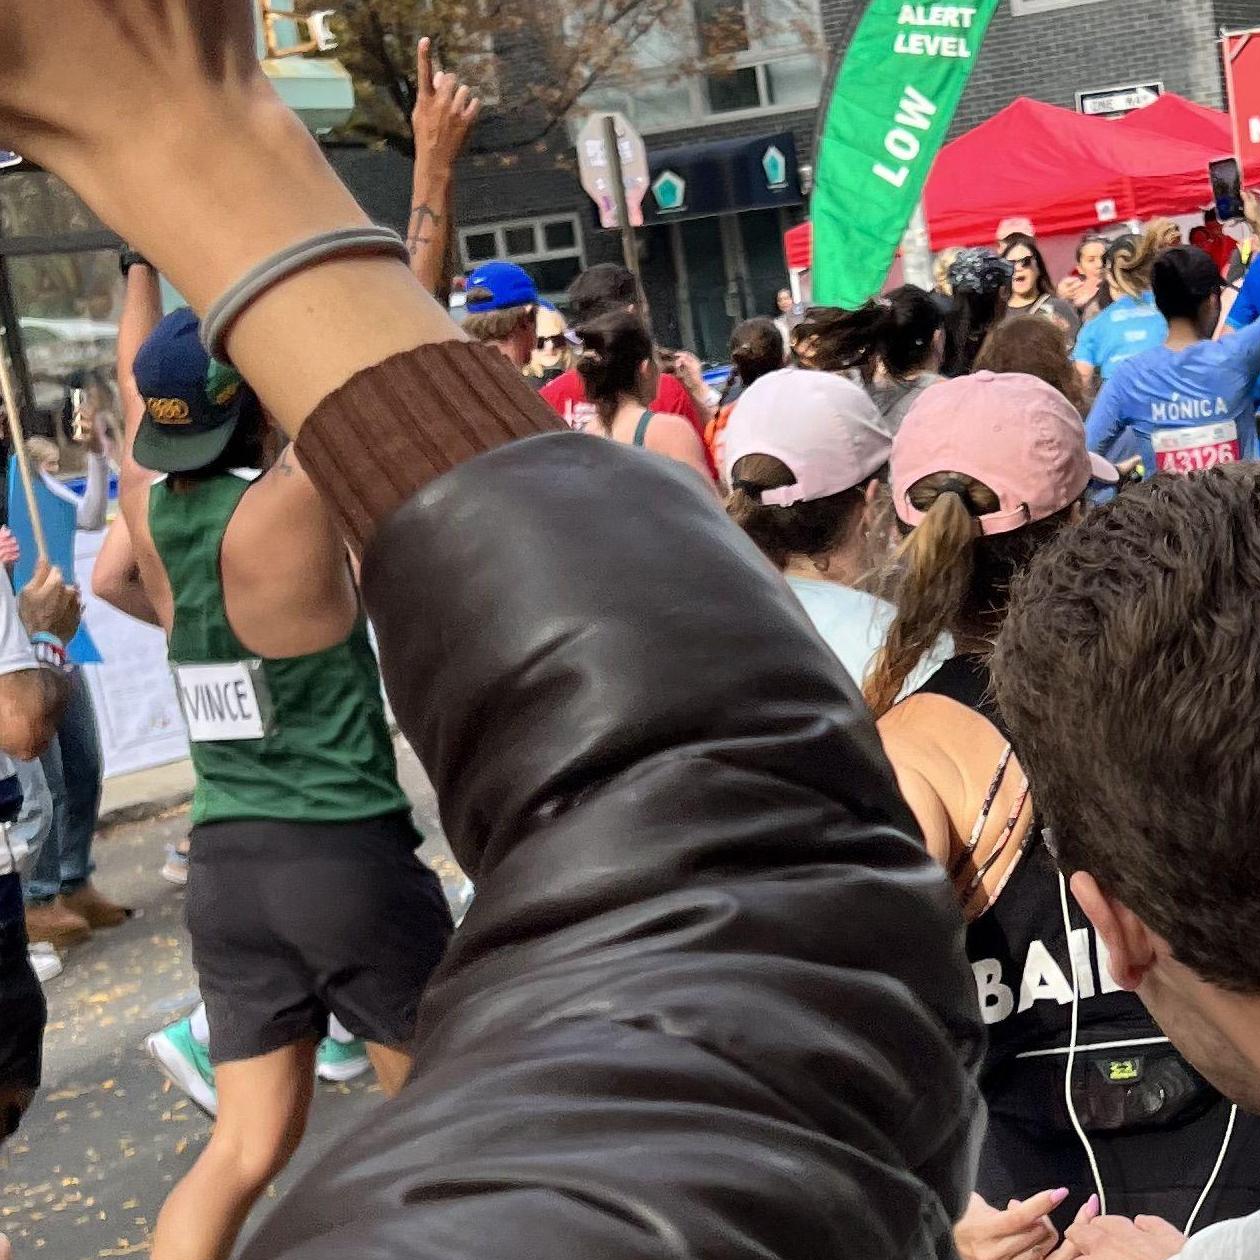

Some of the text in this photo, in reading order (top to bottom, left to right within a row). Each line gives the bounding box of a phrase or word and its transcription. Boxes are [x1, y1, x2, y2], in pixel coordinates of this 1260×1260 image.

[897, 4, 977, 28] ALERT
[893, 32, 972, 58] LEVEL
[872, 84, 938, 188] LOW
[1151, 391, 1229, 422] MÓNICA
[182, 680, 253, 723] VINCE
